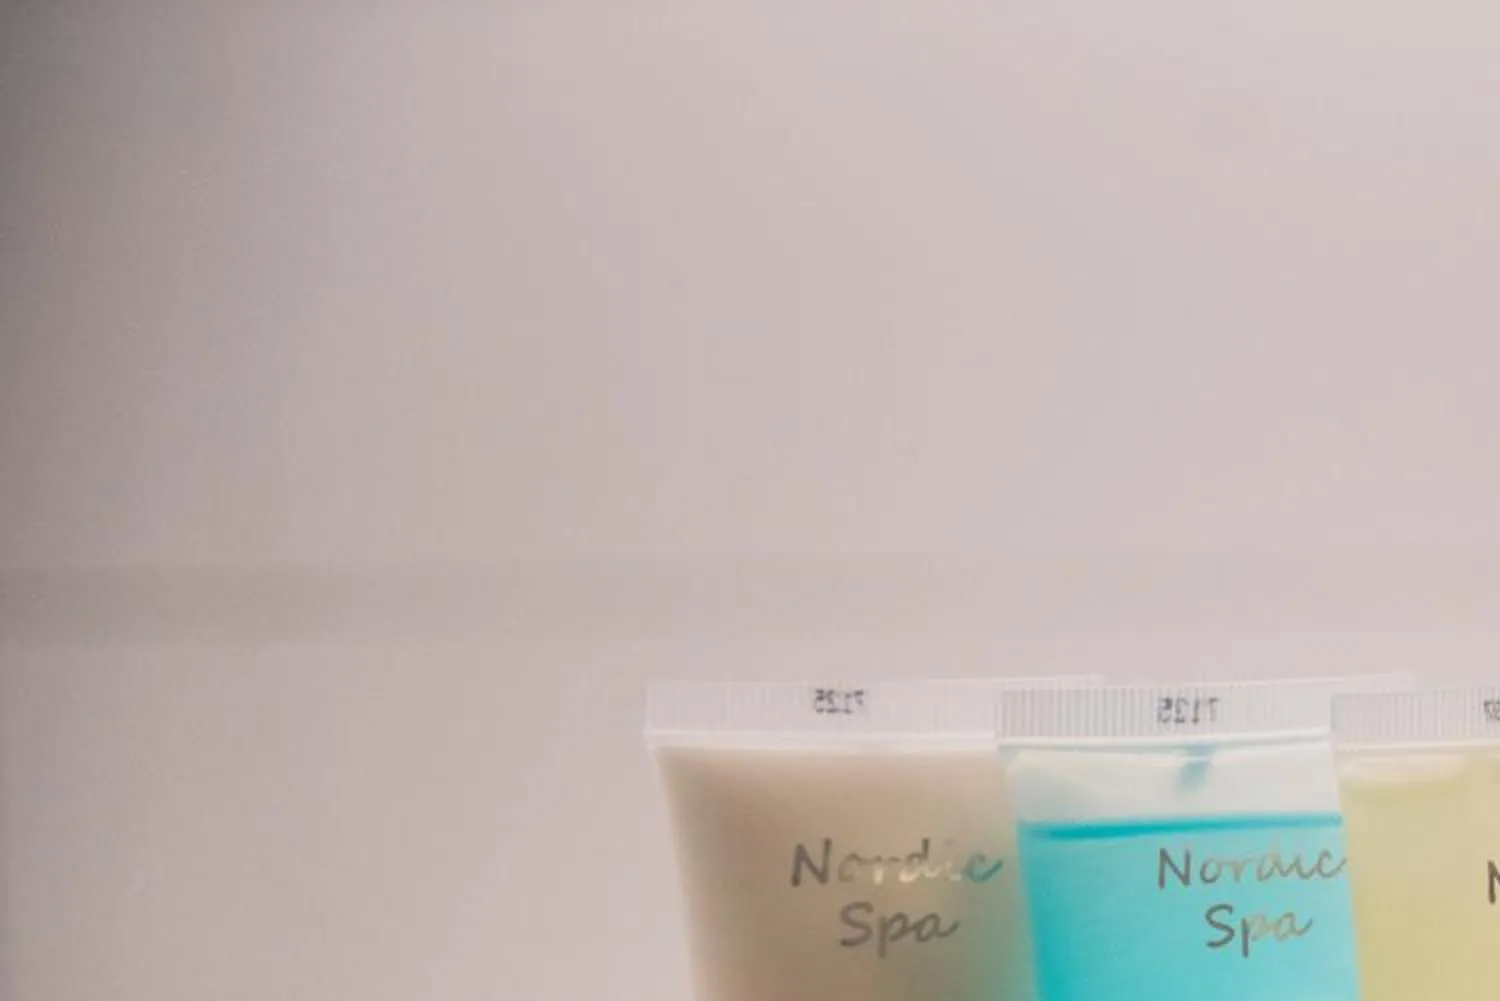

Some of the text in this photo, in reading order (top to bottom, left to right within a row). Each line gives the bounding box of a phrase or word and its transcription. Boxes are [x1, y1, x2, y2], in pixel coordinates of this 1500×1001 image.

[1158, 840, 1348, 890] Nordic
[840, 901, 960, 959] Spa
[1205, 903, 1313, 958] Spa
